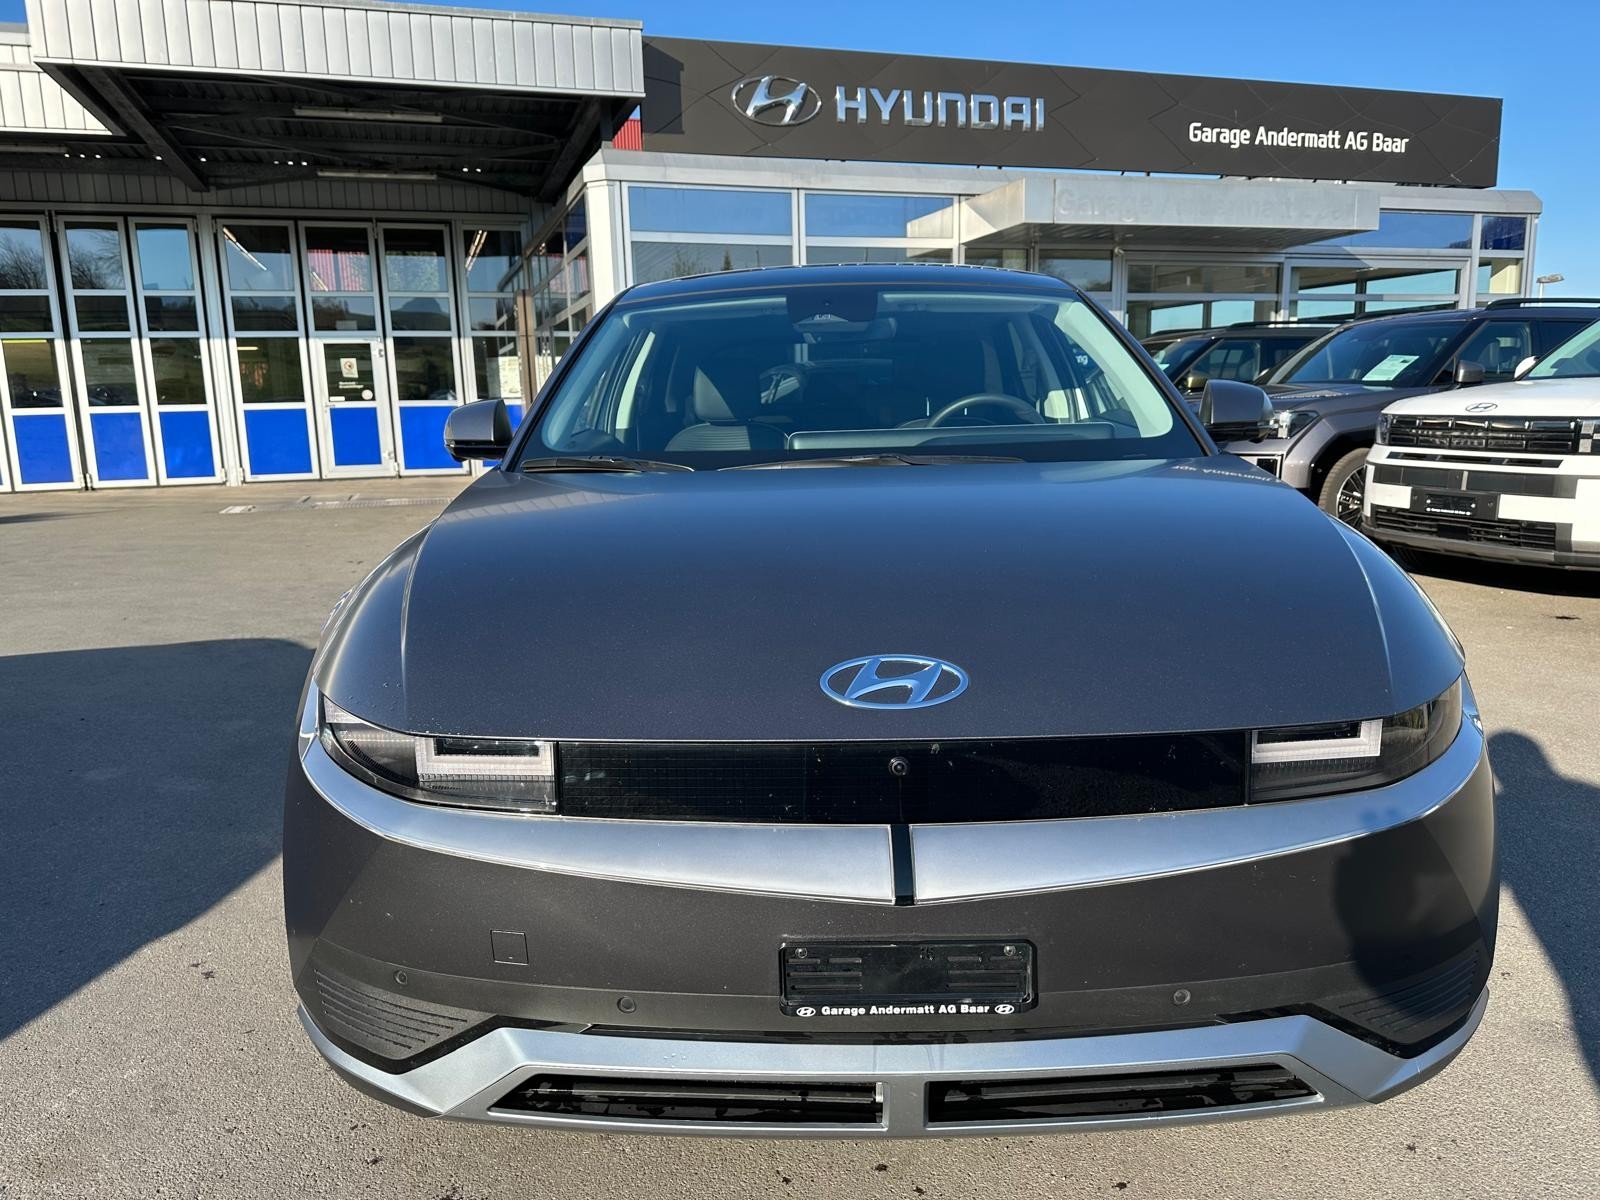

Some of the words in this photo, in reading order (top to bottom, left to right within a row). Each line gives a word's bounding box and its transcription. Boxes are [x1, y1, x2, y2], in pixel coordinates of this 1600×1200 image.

[835, 85, 1045, 131] HYUNDAI
[1188, 122, 1251, 149] Garage
[1254, 126, 1341, 150] Andermatt
[1344, 131, 1369, 151] AG
[1372, 132, 1410, 153] Baar
[821, 1005, 866, 1017] Garage
[869, 1004, 935, 1015] Andermatt
[938, 1004, 957, 1014] AG
[960, 1004, 990, 1014] Baar
